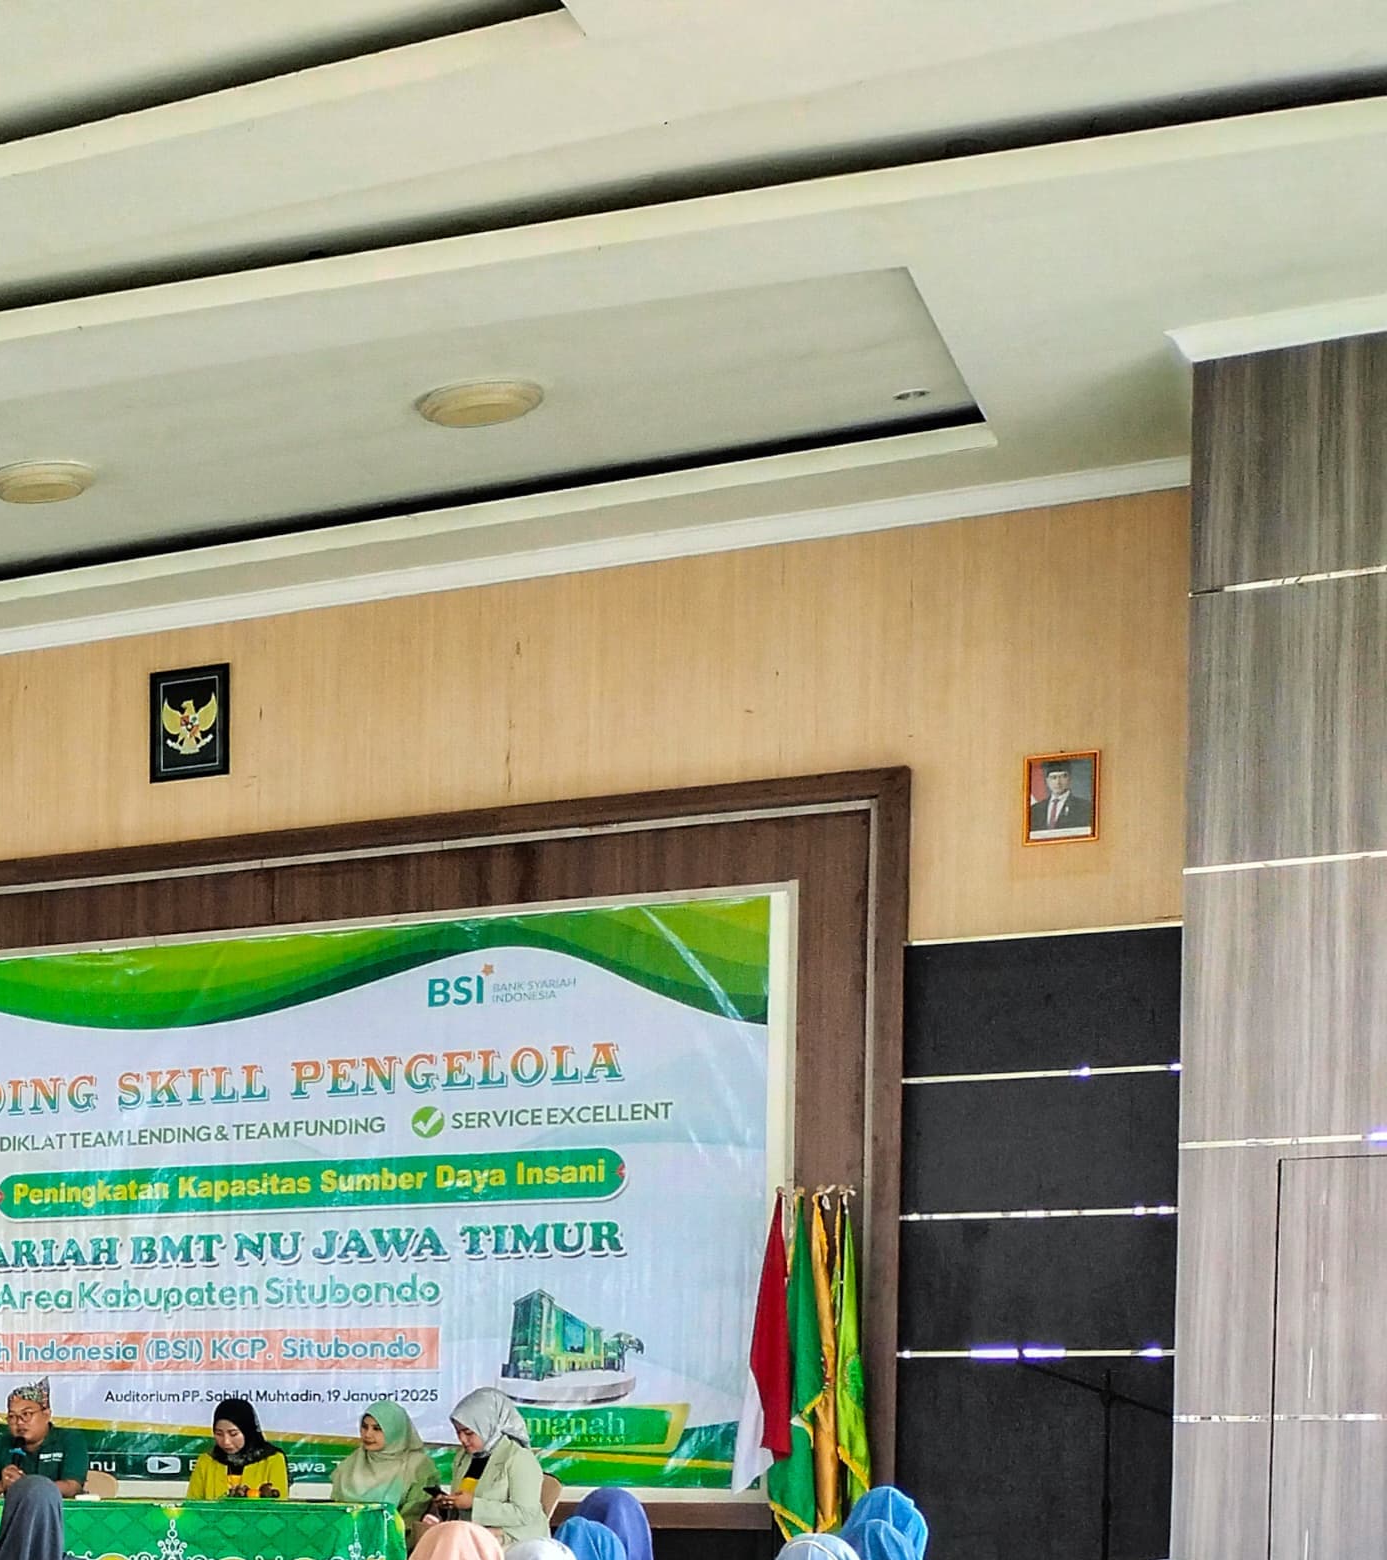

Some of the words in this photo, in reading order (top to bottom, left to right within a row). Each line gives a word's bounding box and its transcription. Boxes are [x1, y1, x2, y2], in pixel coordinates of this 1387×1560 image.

[427, 974, 485, 1008] BSI
[491, 989, 557, 1004] INDONESIA
[492, 982, 525, 993] BANK
[528, 977, 577, 991] SYARIAH
[116, 1063, 270, 1112] SKILL
[290, 1041, 625, 1101] PENGELOLA
[451, 1108, 543, 1130] SERVICE
[546, 1101, 673, 1126] EXCELLENT
[0, 1132, 65, 1154] DIKLAT
[67, 1130, 124, 1150] TEAM
[126, 1125, 214, 1149] LENDING
[232, 1120, 290, 1142] TEAM
[293, 1115, 387, 1139] FUNDING
[12, 1178, 169, 1209] Peningkatan
[179, 1169, 311, 1203] Kapasitas
[321, 1165, 428, 1193] Sumber
[435, 1163, 507, 1194] Daya
[515, 1159, 606, 1186] Insani
[130, 1234, 225, 1268] BMT
[234, 1230, 303, 1265] NU
[311, 1226, 451, 1264] JAWA
[459, 1219, 627, 1259] TIMUR
[77, 1279, 260, 1317] Kabupaten
[264, 1272, 443, 1306] Situbondo
[18, 1339, 138, 1361] Indonesia
[145, 1337, 204, 1363] (BSI)
[210, 1339, 276, 1361] KCP.
[282, 1335, 423, 1359] Situbondo
[104, 1390, 180, 1403] Auditorium
[327, 1389, 340, 1403] 19
[401, 1388, 439, 1403] 2025
